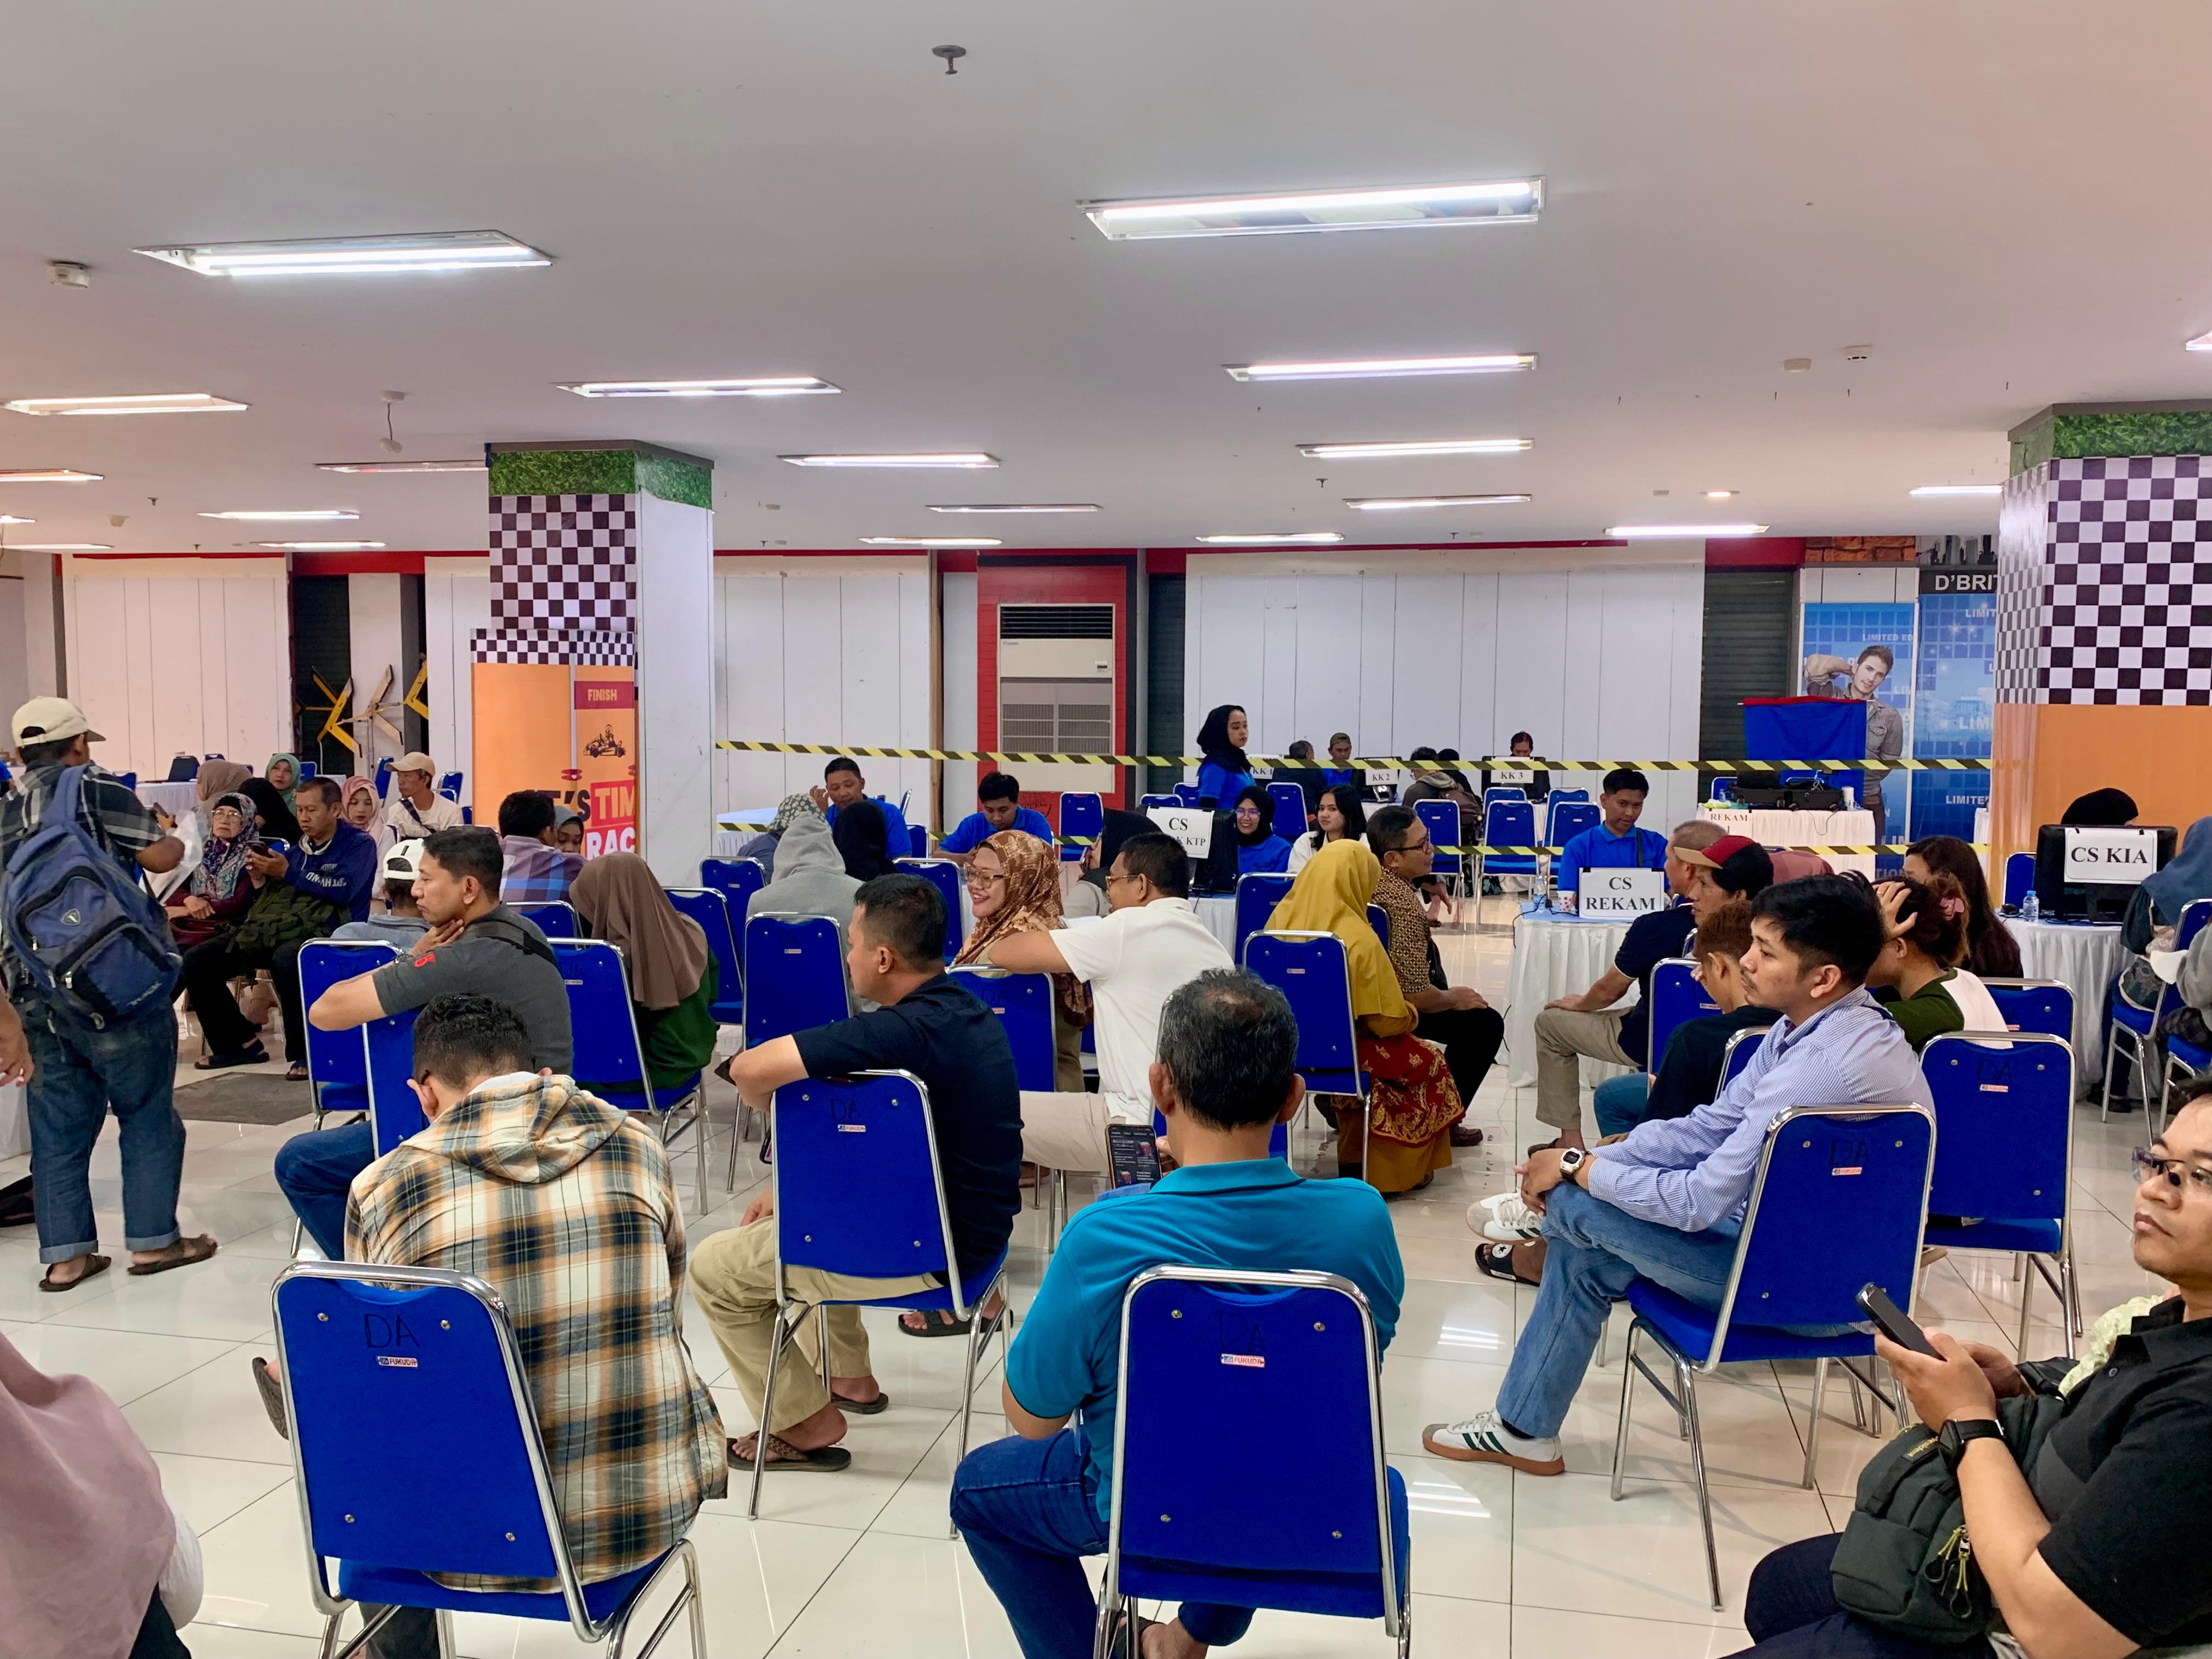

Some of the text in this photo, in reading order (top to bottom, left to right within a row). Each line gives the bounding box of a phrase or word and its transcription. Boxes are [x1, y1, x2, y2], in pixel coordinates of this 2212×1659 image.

[1863, 633, 1898, 642] LIMITED
[587, 689, 617, 701] FINISH
[1169, 817, 1188, 831] CS
[1186, 837, 1206, 846] KTP
[2071, 847, 2148, 864] CS KIA
[1609, 877, 1632, 890] CS
[1585, 897, 1656, 910] REKAM
[364, 1313, 421, 1348] DA
[389, 1357, 417, 1366] FUKUDA
[1234, 1356, 1263, 1365] FUKUDA
